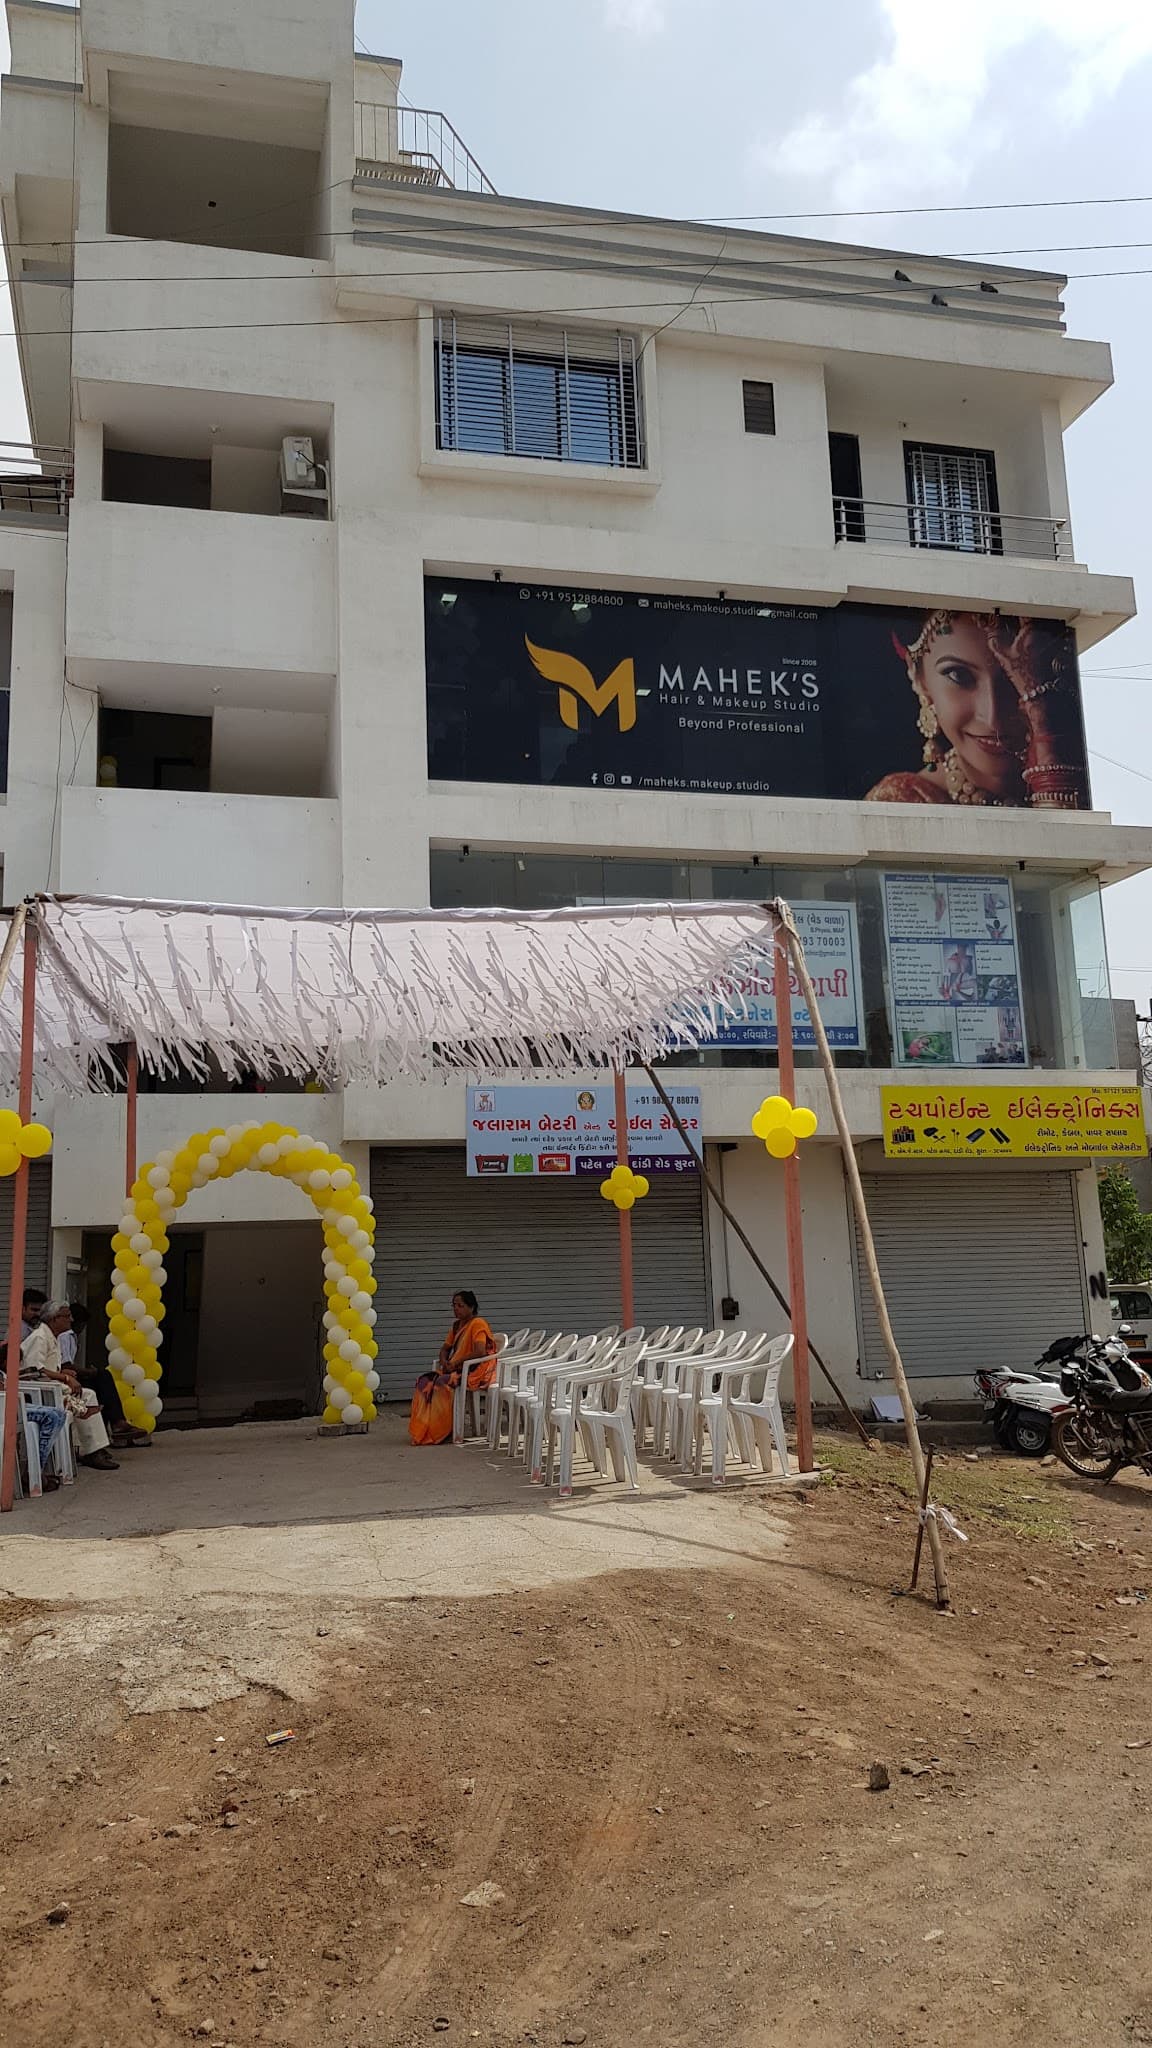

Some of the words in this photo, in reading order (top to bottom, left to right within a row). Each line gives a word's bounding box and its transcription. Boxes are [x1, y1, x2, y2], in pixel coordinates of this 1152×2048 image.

[535, 591, 554, 601] +91
[558, 592, 624, 606] 9512884800
[658, 663, 820, 698] MAHEK'S
[660, 693, 690, 705] Hair
[697, 695, 705, 705] &
[712, 696, 767, 710] Makeup
[774, 699, 820, 712] Studio
[678, 717, 723, 731] Beyond
[728, 719, 804, 733] Professional
[638, 776, 770, 791] /maheks.makeup.studio
[817, 936, 846, 946] 70003
[634, 1096, 650, 1105] +91
[889, 1096, 992, 1119] ટચપોઈન્ટ
[1007, 1095, 1140, 1123] ઈલેક્ટ્રોનિક્સ
[472, 1119, 531, 1131] જલારામ
[538, 1113, 577, 1131] બેટરી
[580, 1158, 602, 1169] પટેલ
[631, 1157, 652, 1169] દાંડી
[654, 1157, 671, 1169] રોડ
[673, 1159, 696, 1171] સુરત
[1089, 1270, 1108, 1299] N
